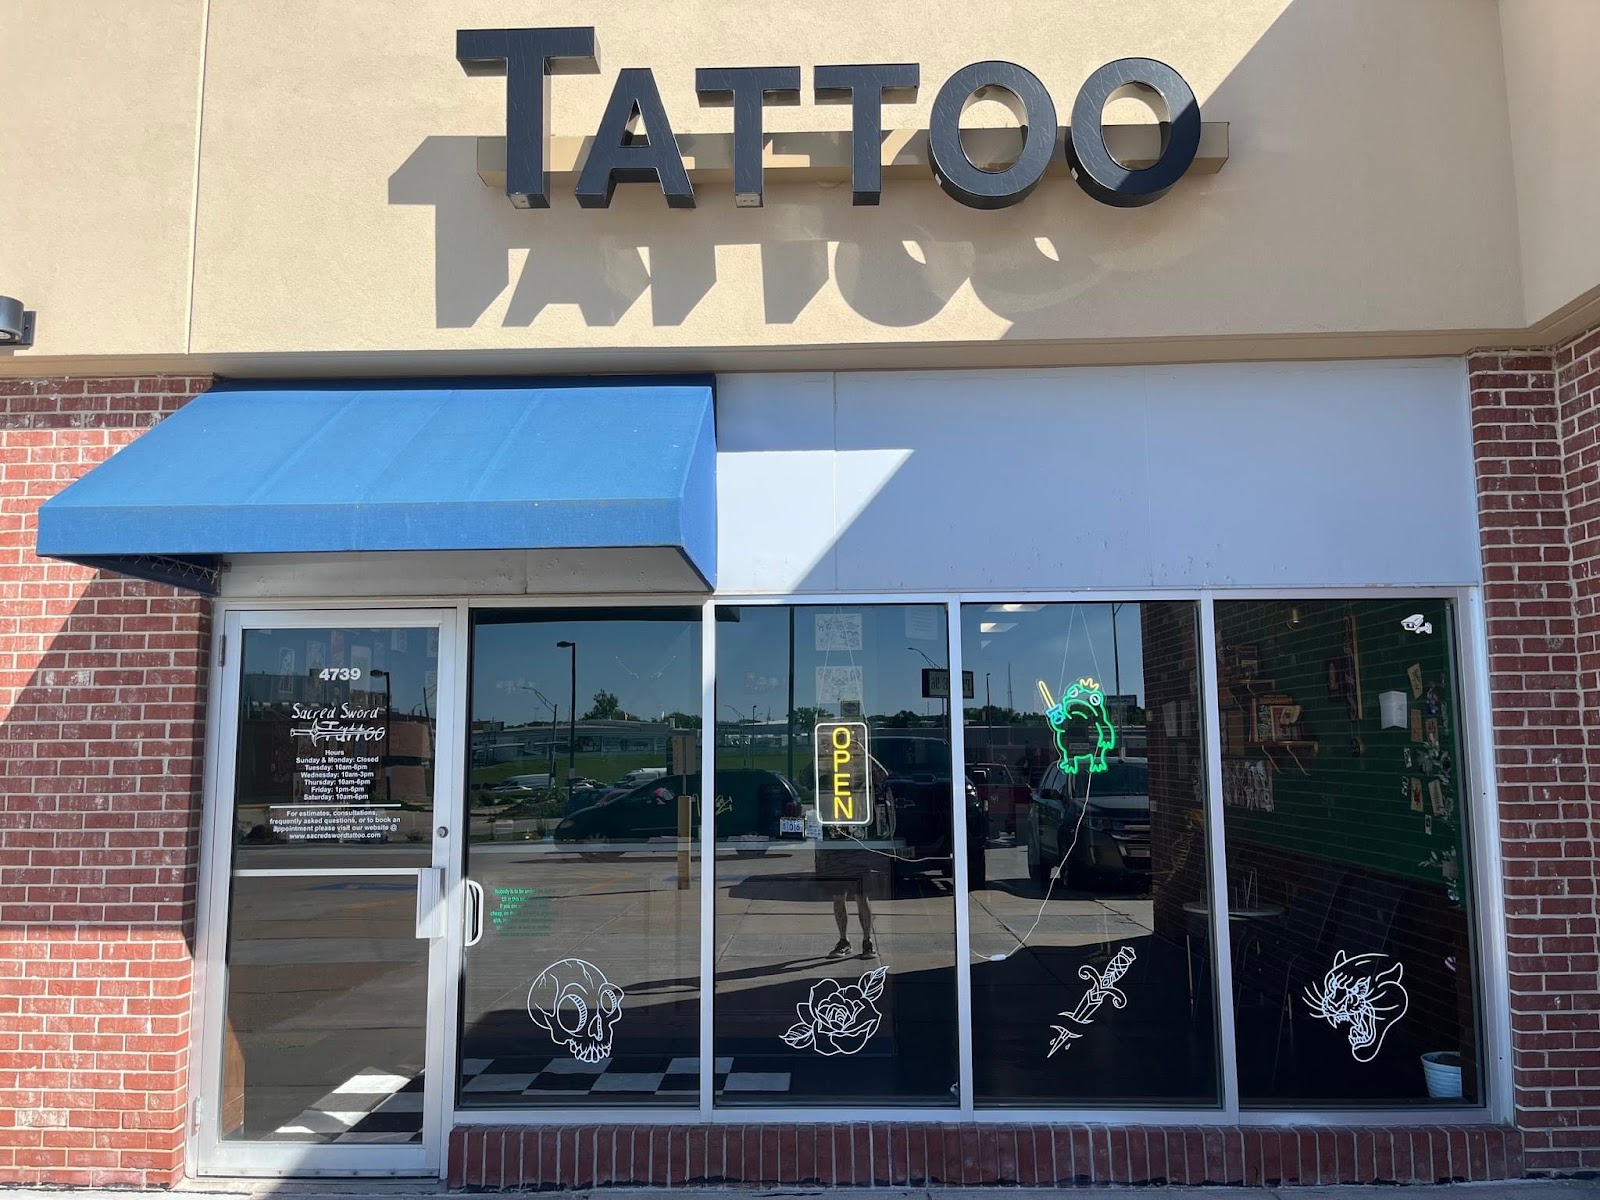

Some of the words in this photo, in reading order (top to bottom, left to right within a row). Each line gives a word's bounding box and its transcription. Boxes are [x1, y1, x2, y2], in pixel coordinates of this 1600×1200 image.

[456, 27, 1201, 208] TATTOO
[319, 668, 361, 681] 4739
[291, 702, 337, 720] Sacred
[340, 702, 380, 719] Sword
[832, 727, 854, 820] OPEN
